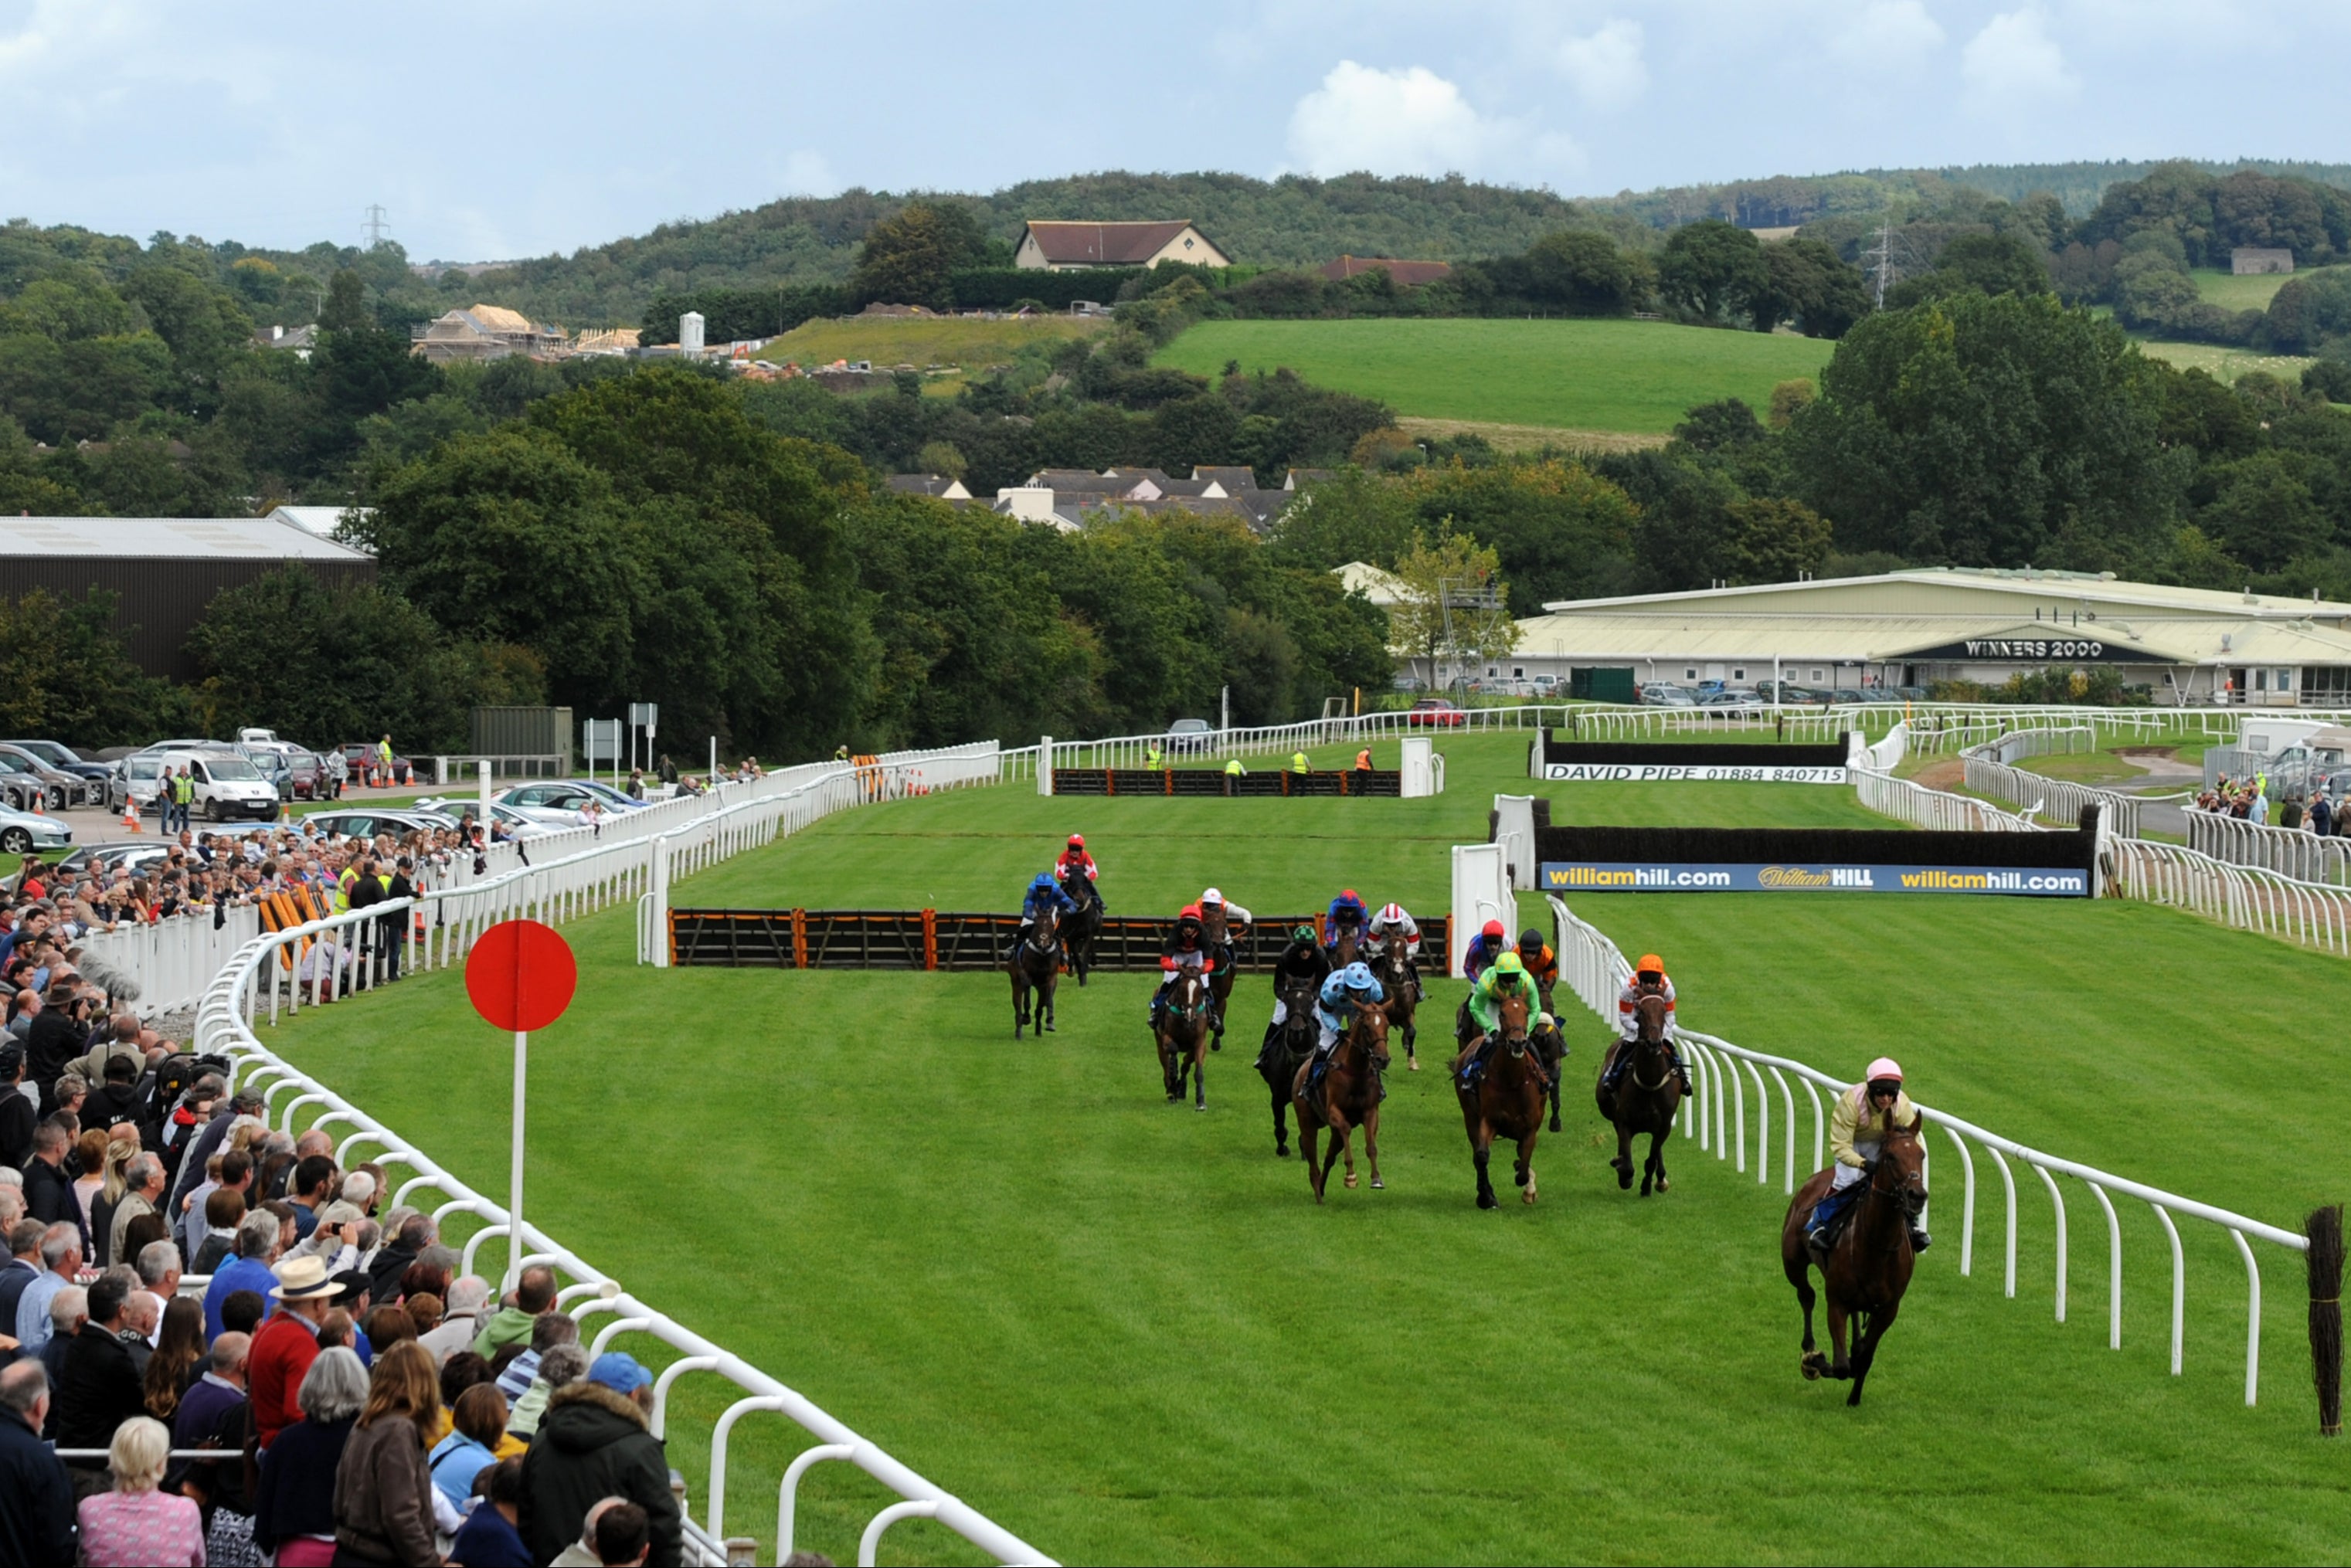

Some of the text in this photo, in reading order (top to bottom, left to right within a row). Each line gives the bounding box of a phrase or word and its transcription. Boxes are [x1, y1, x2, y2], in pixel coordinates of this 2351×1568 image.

[1965, 641, 2102, 656] WINNERS 2000
[1550, 765, 1842, 782] DAVID PIPE 01884 840715
[1549, 867, 1730, 886] williamhill.com
[1758, 866, 1874, 888] William HILL
[1901, 871, 2081, 890] williamhill.com
